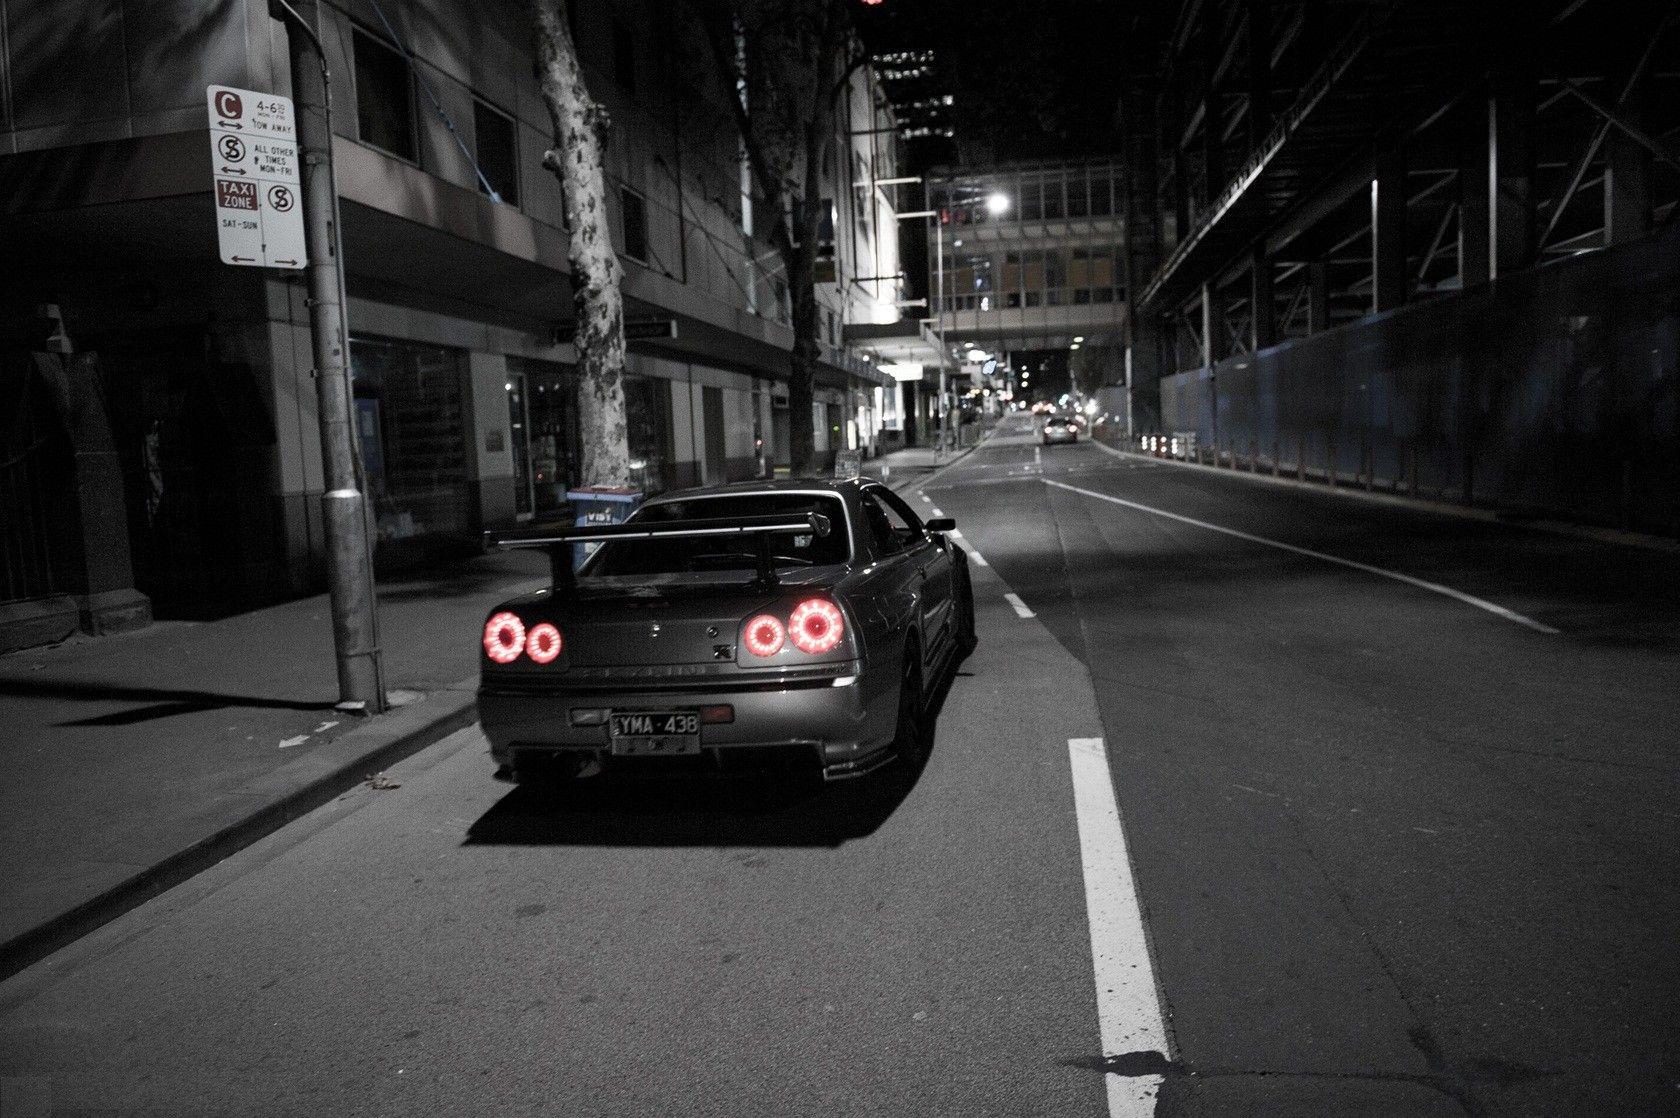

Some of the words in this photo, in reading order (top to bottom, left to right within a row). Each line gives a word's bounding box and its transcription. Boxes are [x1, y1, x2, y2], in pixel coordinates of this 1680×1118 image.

[254, 144, 267, 154] ALL
[271, 146, 294, 157] OTHER
[265, 155, 286, 166] TIMES
[220, 181, 255, 196] TAXI
[224, 195, 253, 209] ZONE
